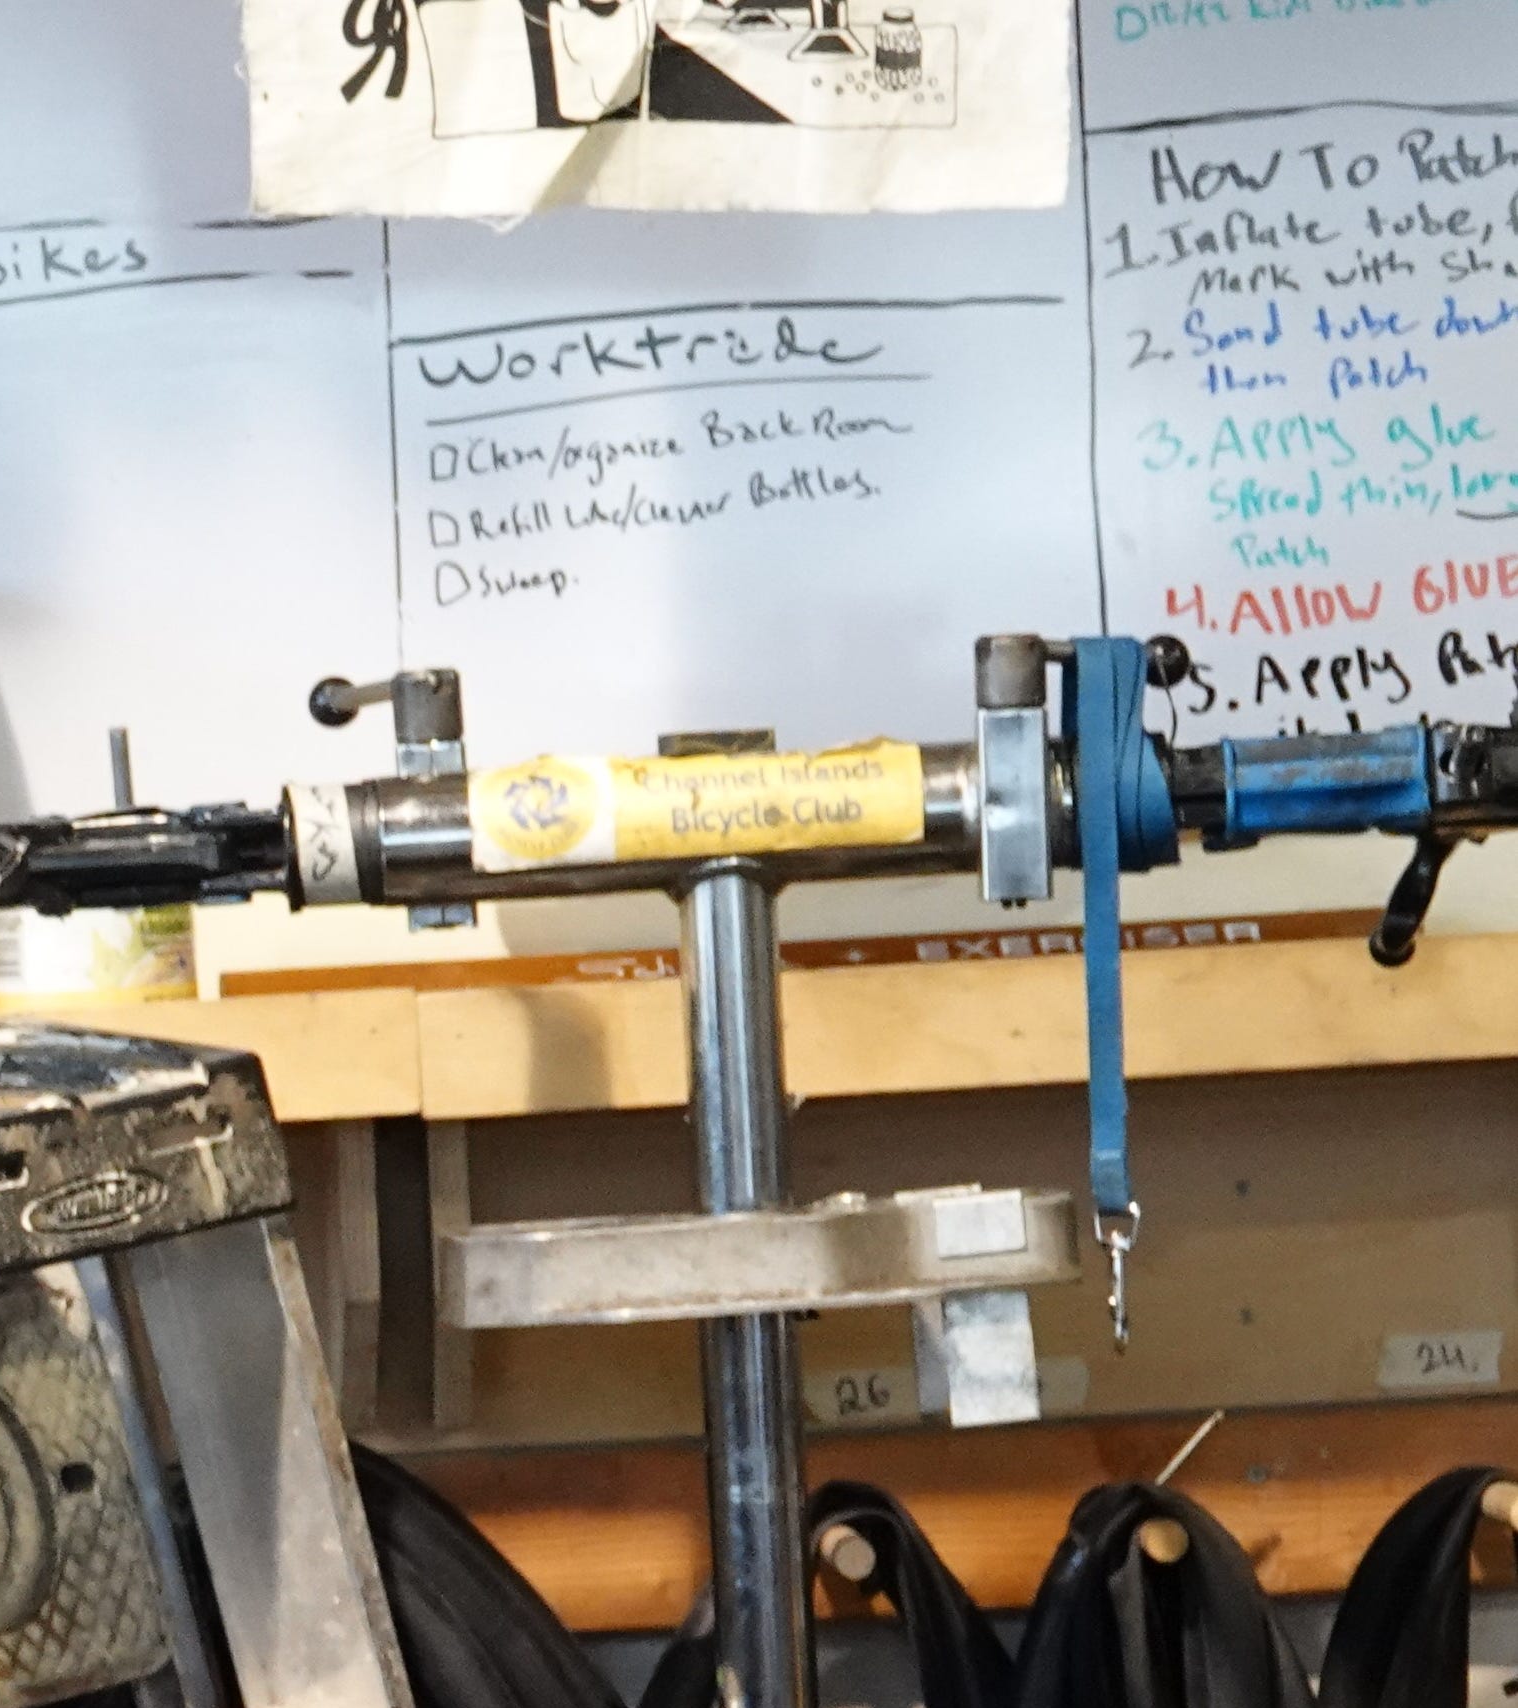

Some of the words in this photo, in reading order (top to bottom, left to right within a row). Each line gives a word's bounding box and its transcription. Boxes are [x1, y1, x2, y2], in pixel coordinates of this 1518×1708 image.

[1150, 143, 1282, 205] How
[1299, 141, 1381, 191] To
[1188, 262, 1302, 307] Mark
[1324, 247, 1415, 285] with
[1182, 299, 1282, 358] Sand
[1313, 303, 1420, 343] tube
[1199, 362, 1288, 395] then
[700, 407, 804, 449] Back
[810, 404, 915, 441] Room
[1209, 412, 1358, 470] Apply
[1385, 400, 1496, 473] glue
[470, 501, 554, 540] Refill
[1230, 530, 1332, 569] Patch
[1253, 645, 1412, 705] Apply
[644, 766, 769, 796] Channel
[780, 757, 886, 782] Islands
[670, 799, 787, 835] Bicycle
[792, 797, 864, 826] Club
[834, 1374, 891, 1416] 26
